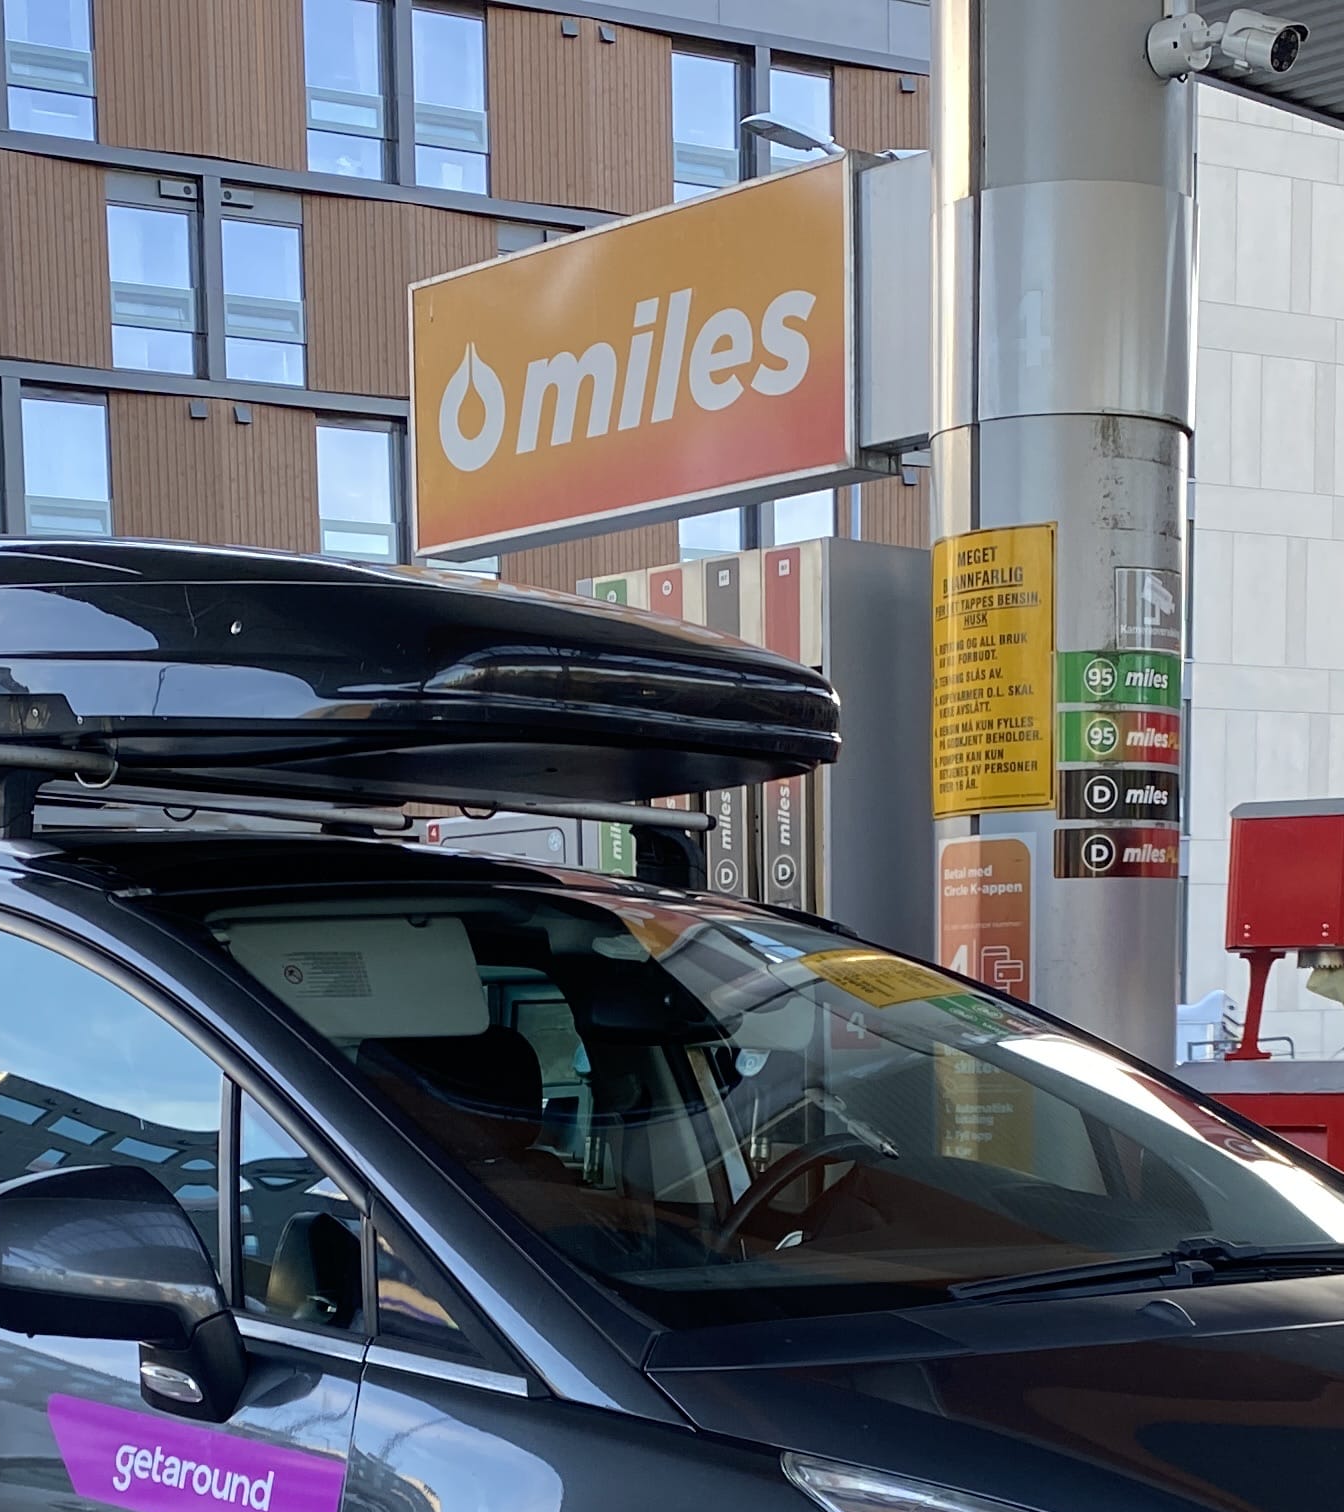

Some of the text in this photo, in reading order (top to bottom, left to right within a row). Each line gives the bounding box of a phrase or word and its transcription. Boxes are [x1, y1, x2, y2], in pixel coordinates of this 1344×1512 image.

[515, 286, 817, 455] miles
[958, 546, 998, 568] MEGET
[961, 596, 994, 611] TAPPES
[964, 612, 988, 626] HUSK
[967, 638, 977, 649] OG
[980, 635, 996, 646] ALL
[999, 632, 1028, 645] BRUK
[966, 668, 986, 681] SLÅS
[989, 668, 1003, 679] AV.
[1088, 667, 1168, 689] 95 miles
[1008, 684, 1034, 696] SKAL
[962, 720, 973, 734] MÅ
[976, 718, 994, 731] KUN
[997, 716, 1034, 729] FYLLES
[1089, 727, 1114, 746] 95
[966, 751, 982, 762] KAN
[985, 748, 1004, 761] KUN
[971, 764, 982, 775] AV
[985, 760, 1038, 774] PERSONER
[1093, 785, 1168, 806] D miles
[719, 791, 732, 850] miles
[778, 785, 791, 846] miles
[610, 822, 622, 860] mil
[1090, 844, 1109, 862] D
[944, 865, 993, 880] Betal med
[944, 882, 1023, 897] Circle K-appen
[113, 1444, 275, 1512] getaround
